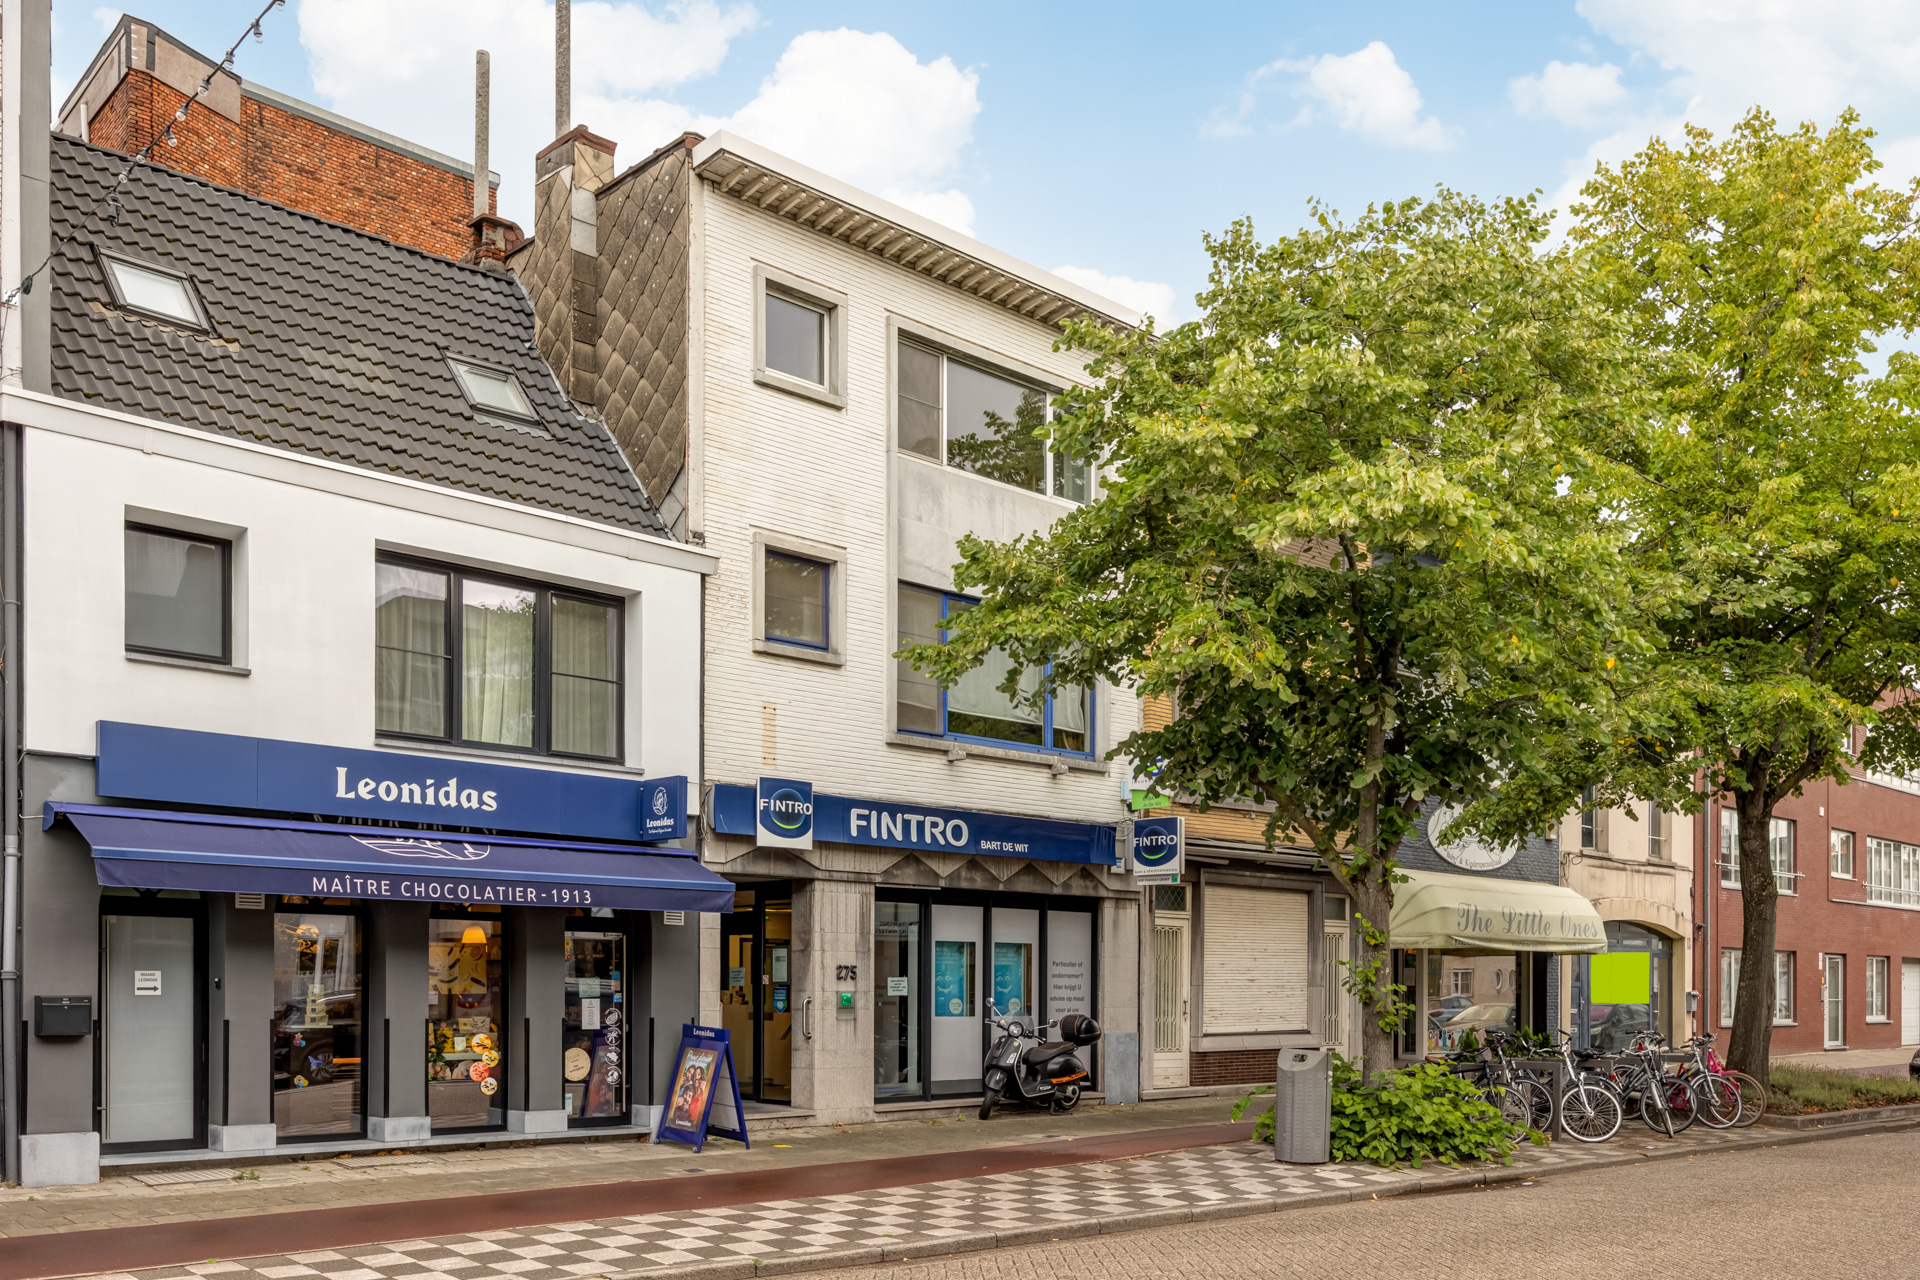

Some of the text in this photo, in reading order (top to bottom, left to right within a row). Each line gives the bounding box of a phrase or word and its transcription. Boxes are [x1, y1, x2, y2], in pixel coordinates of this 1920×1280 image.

[335, 767, 498, 812] Leonidas
[759, 798, 813, 816] FINTRO
[646, 816, 675, 828] Leonidas
[850, 808, 969, 847] FINTRO
[980, 840, 1029, 853] BART DE WIT
[1133, 835, 1178, 848] FINTRO
[312, 874, 391, 896] MAÎTRE
[1457, 902, 1598, 938] The Little Ones
[836, 964, 857, 980] 275
[693, 1028, 715, 1038] Leonidas
[675, 1118, 692, 1127] Leonidas
